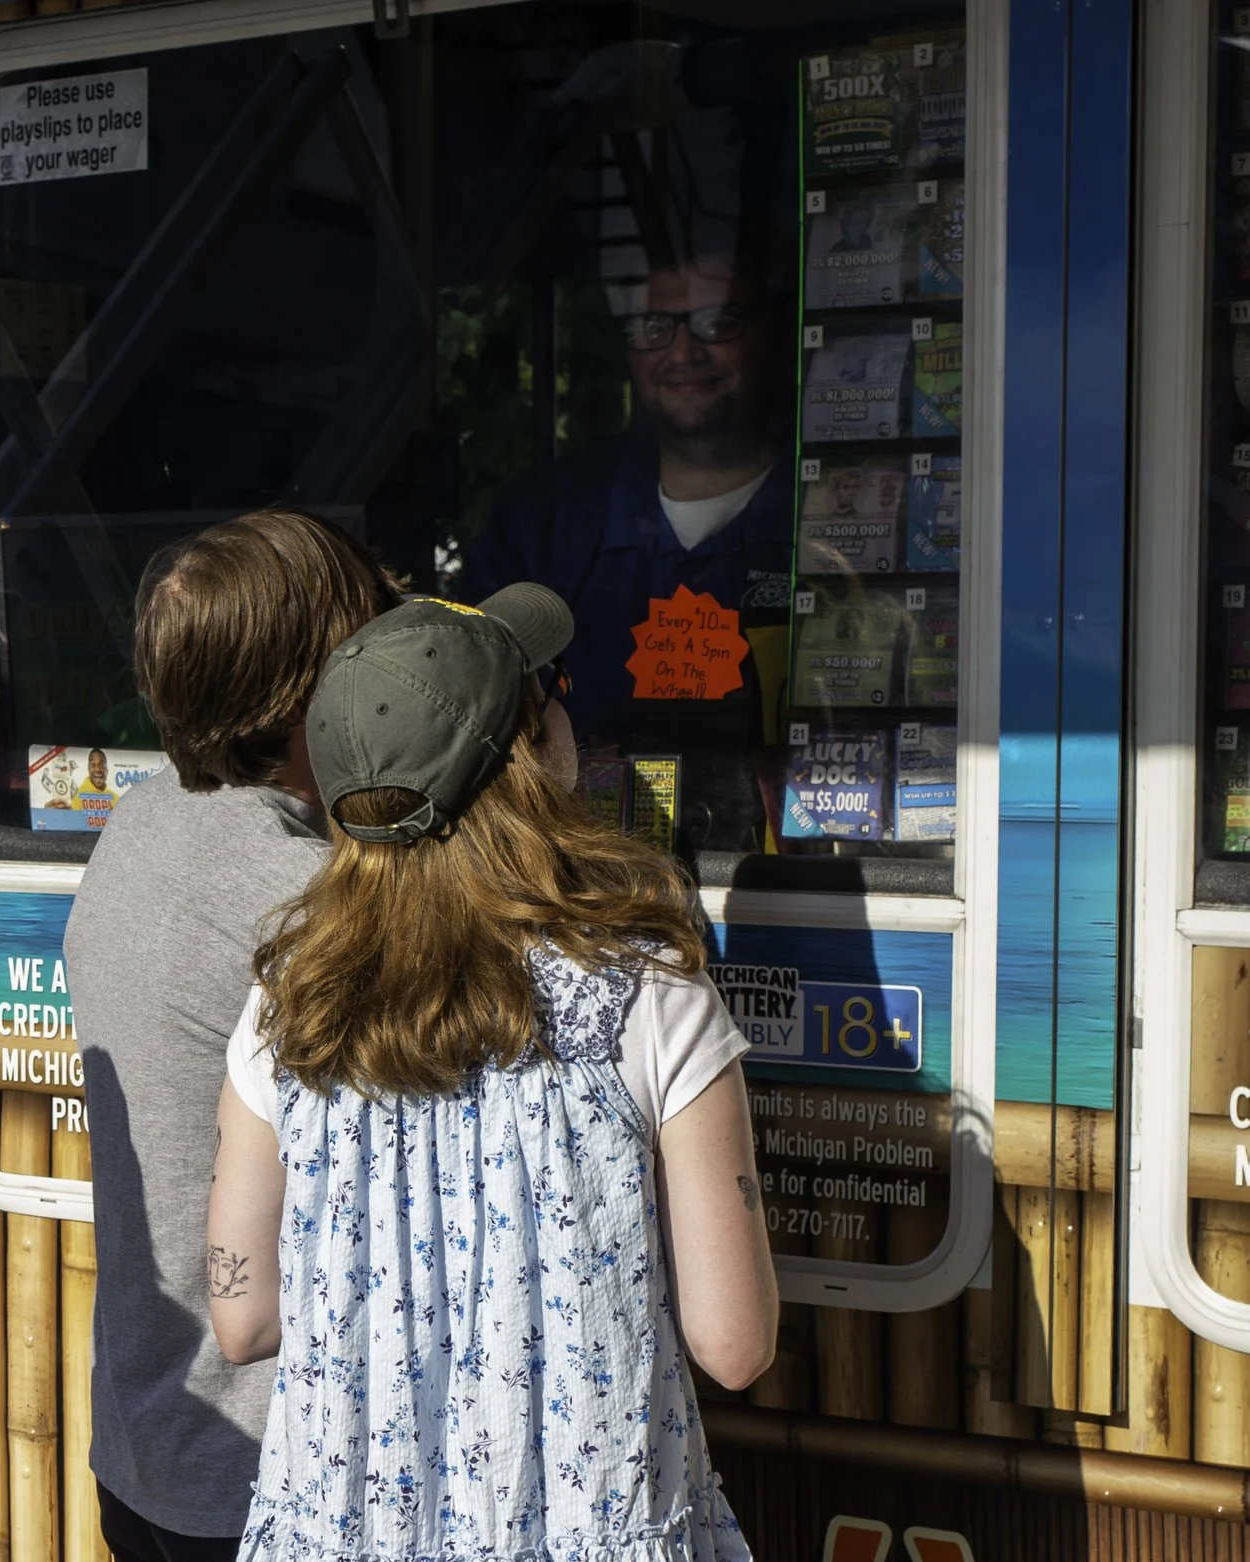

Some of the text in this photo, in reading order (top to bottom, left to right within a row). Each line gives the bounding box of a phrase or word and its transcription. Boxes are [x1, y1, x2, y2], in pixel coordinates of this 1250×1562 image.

[1240, 15, 1249, 26] 3
[920, 48, 928, 59] 2
[27, 82, 115, 109] Please use
[823, 73, 886, 102] 500X
[0, 108, 143, 149] playslips to place
[25, 151, 62, 178] your
[67, 145, 117, 171] wager
[1238, 158, 1246, 170] 7
[924, 186, 932, 197] 6
[812, 196, 819, 207] 5
[827, 251, 899, 268] $2,000,000!
[923, 258, 950, 285] NEW!
[1234, 307, 1248, 318] 11
[810, 331, 818, 342] 9
[915, 324, 929, 335] 10
[825, 387, 895, 402] $1,000,000!
[918, 402, 944, 430] NEW!
[804, 465, 817, 476] 13
[914, 459, 928, 470] 14
[824, 524, 889, 537] $500,000!
[912, 531, 937, 560] NEW!
[799, 597, 812, 608] 17
[909, 594, 922, 605] 18
[1226, 591, 1241, 602] 19
[658, 610, 693, 634] Every
[644, 634, 730, 663] Gets A Spin
[656, 661, 706, 681] On The
[824, 657, 881, 669] $50,000!
[792, 729, 805, 739] 21
[902, 728, 917, 739] 22
[1218, 733, 1234, 744] 23
[802, 742, 876, 762] LUCKY
[810, 764, 857, 785] DOG
[799, 790, 815, 801] WIN
[815, 789, 869, 815] $5,000!
[790, 803, 813, 832] NEW!
[8, 957, 44, 992] WE
[813, 996, 911, 1058] 18+
[799, 1092, 815, 1119] is
[821, 1094, 888, 1131] always
[895, 1100, 926, 1128] the
[765, 1128, 846, 1166] Michigan
[853, 1136, 933, 1169] Problem
[780, 1168, 807, 1195] for
[812, 1173, 926, 1207] confidential
